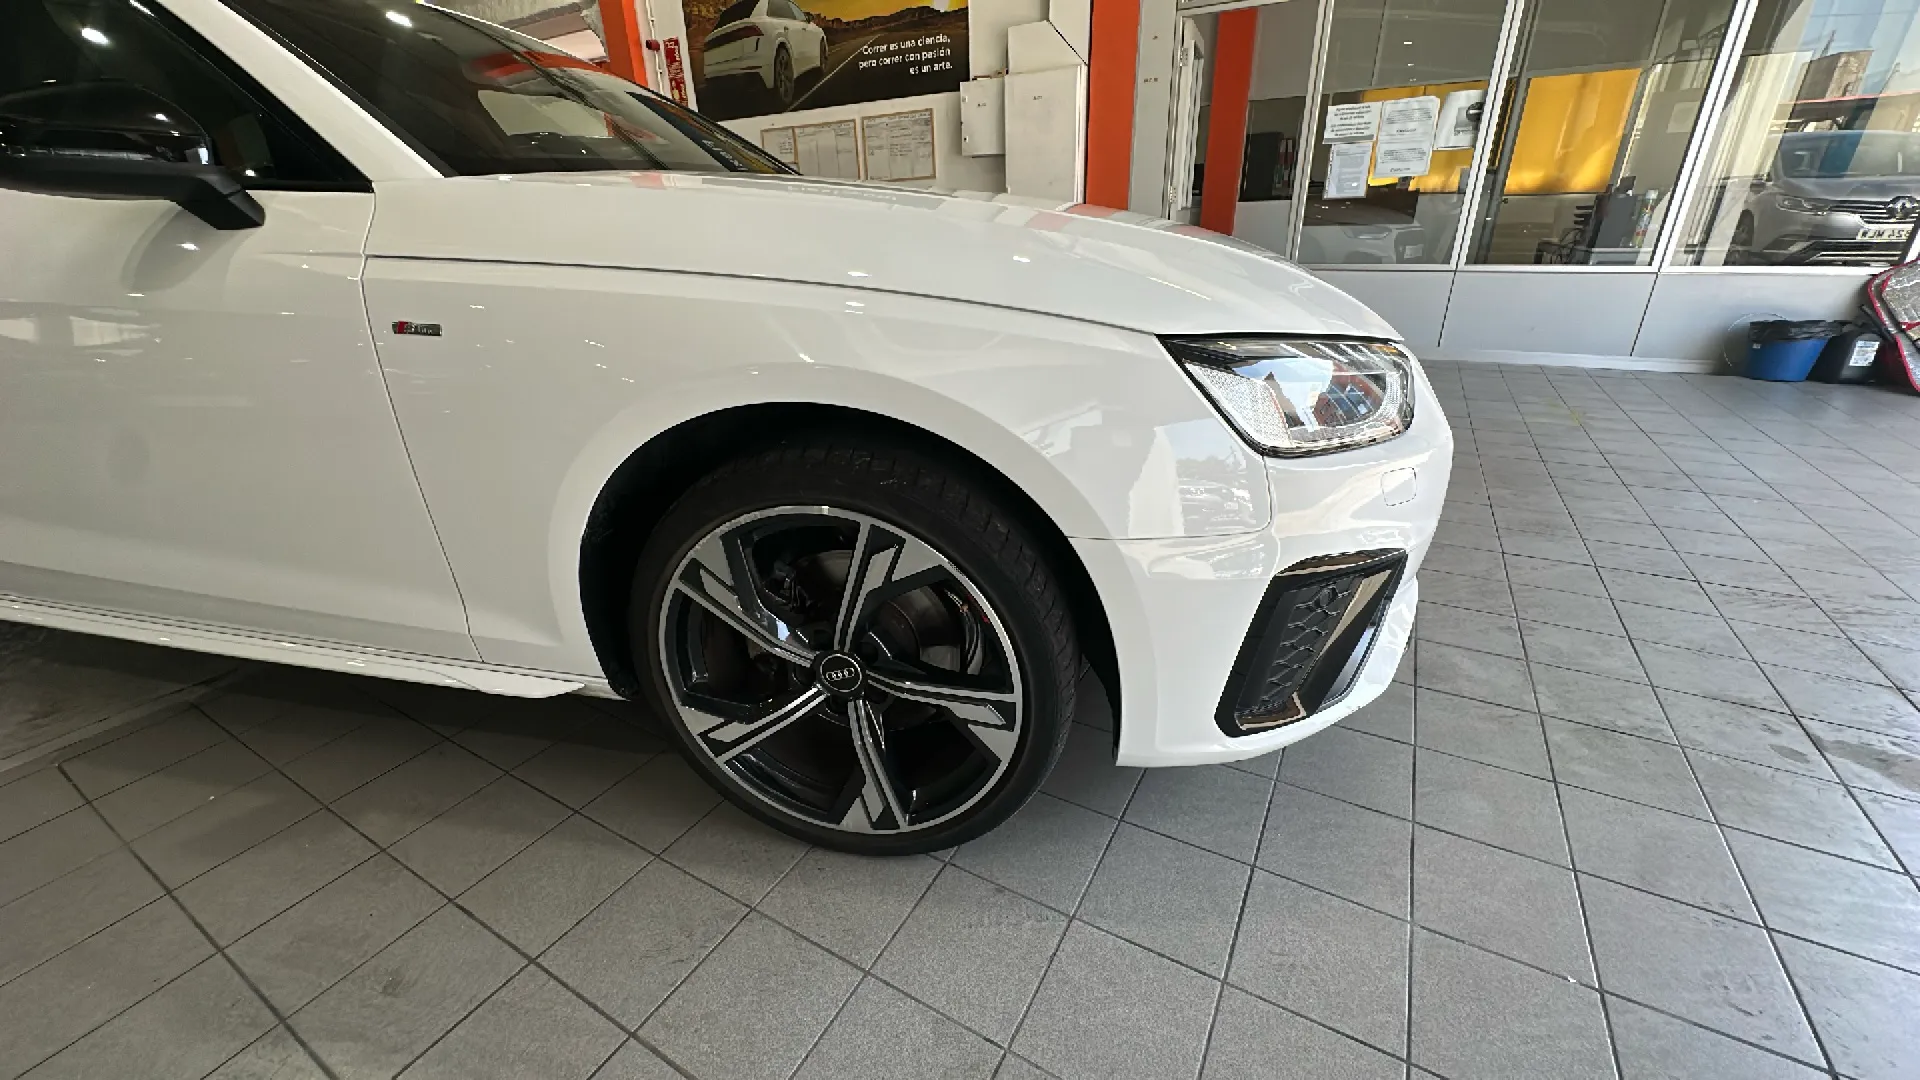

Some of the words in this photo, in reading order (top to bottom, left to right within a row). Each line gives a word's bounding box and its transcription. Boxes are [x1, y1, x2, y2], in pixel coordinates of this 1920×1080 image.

[862, 44, 888, 54] Correr
[900, 40, 916, 48] una
[918, 34, 950, 46] ciencia,
[859, 60, 876, 70] pero
[879, 55, 902, 65] correr
[905, 53, 920, 62] con
[922, 47, 950, 60] pasión
[910, 66, 919, 74] es
[934, 62, 952, 71] arte.
